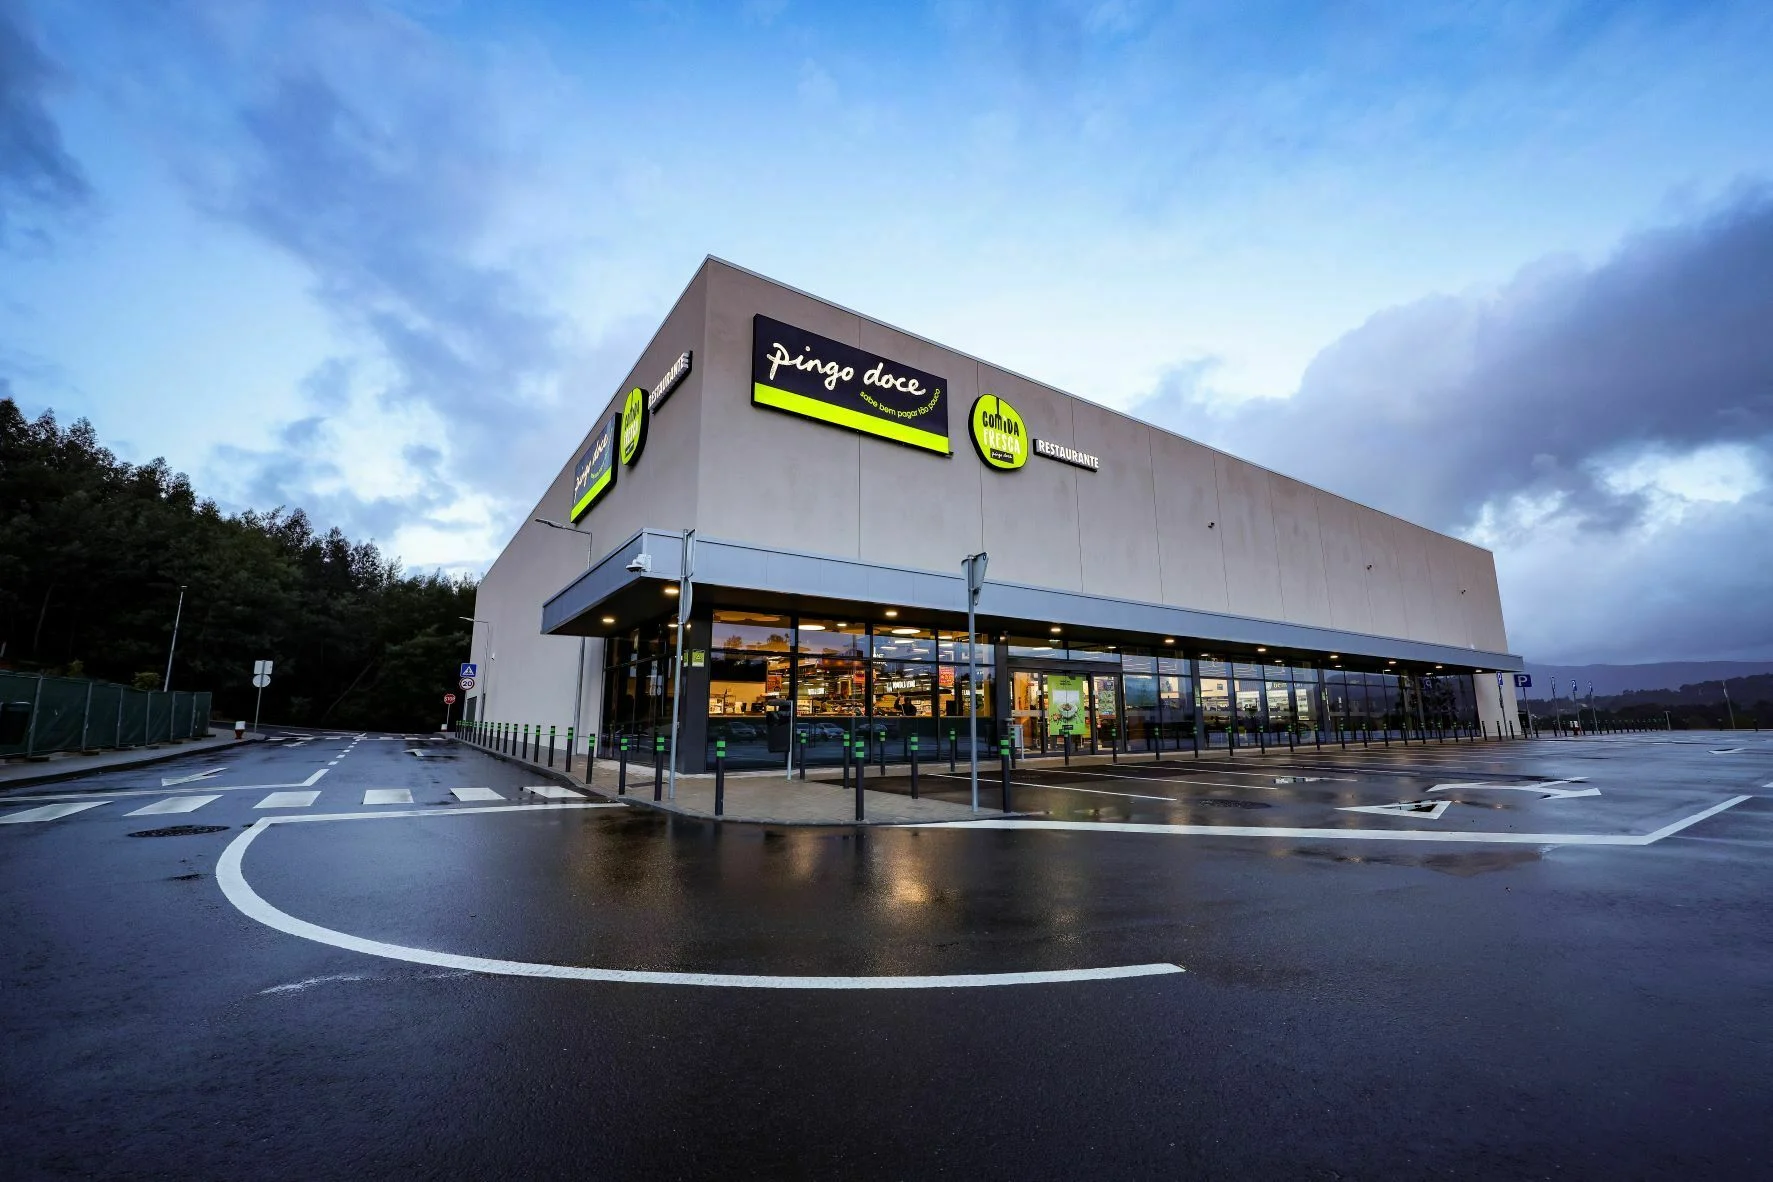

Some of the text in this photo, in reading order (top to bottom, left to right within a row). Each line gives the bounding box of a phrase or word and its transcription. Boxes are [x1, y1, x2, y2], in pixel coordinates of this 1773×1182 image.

[648, 352, 689, 410] RESTAURANTE
[766, 342, 927, 396] pingo doce
[860, 388, 941, 420] sabe bem pagar tão pouco
[983, 426, 1021, 455] FRESCA
[1039, 440, 1100, 469] RESTAURANTE
[1518, 676, 1527, 687] P
